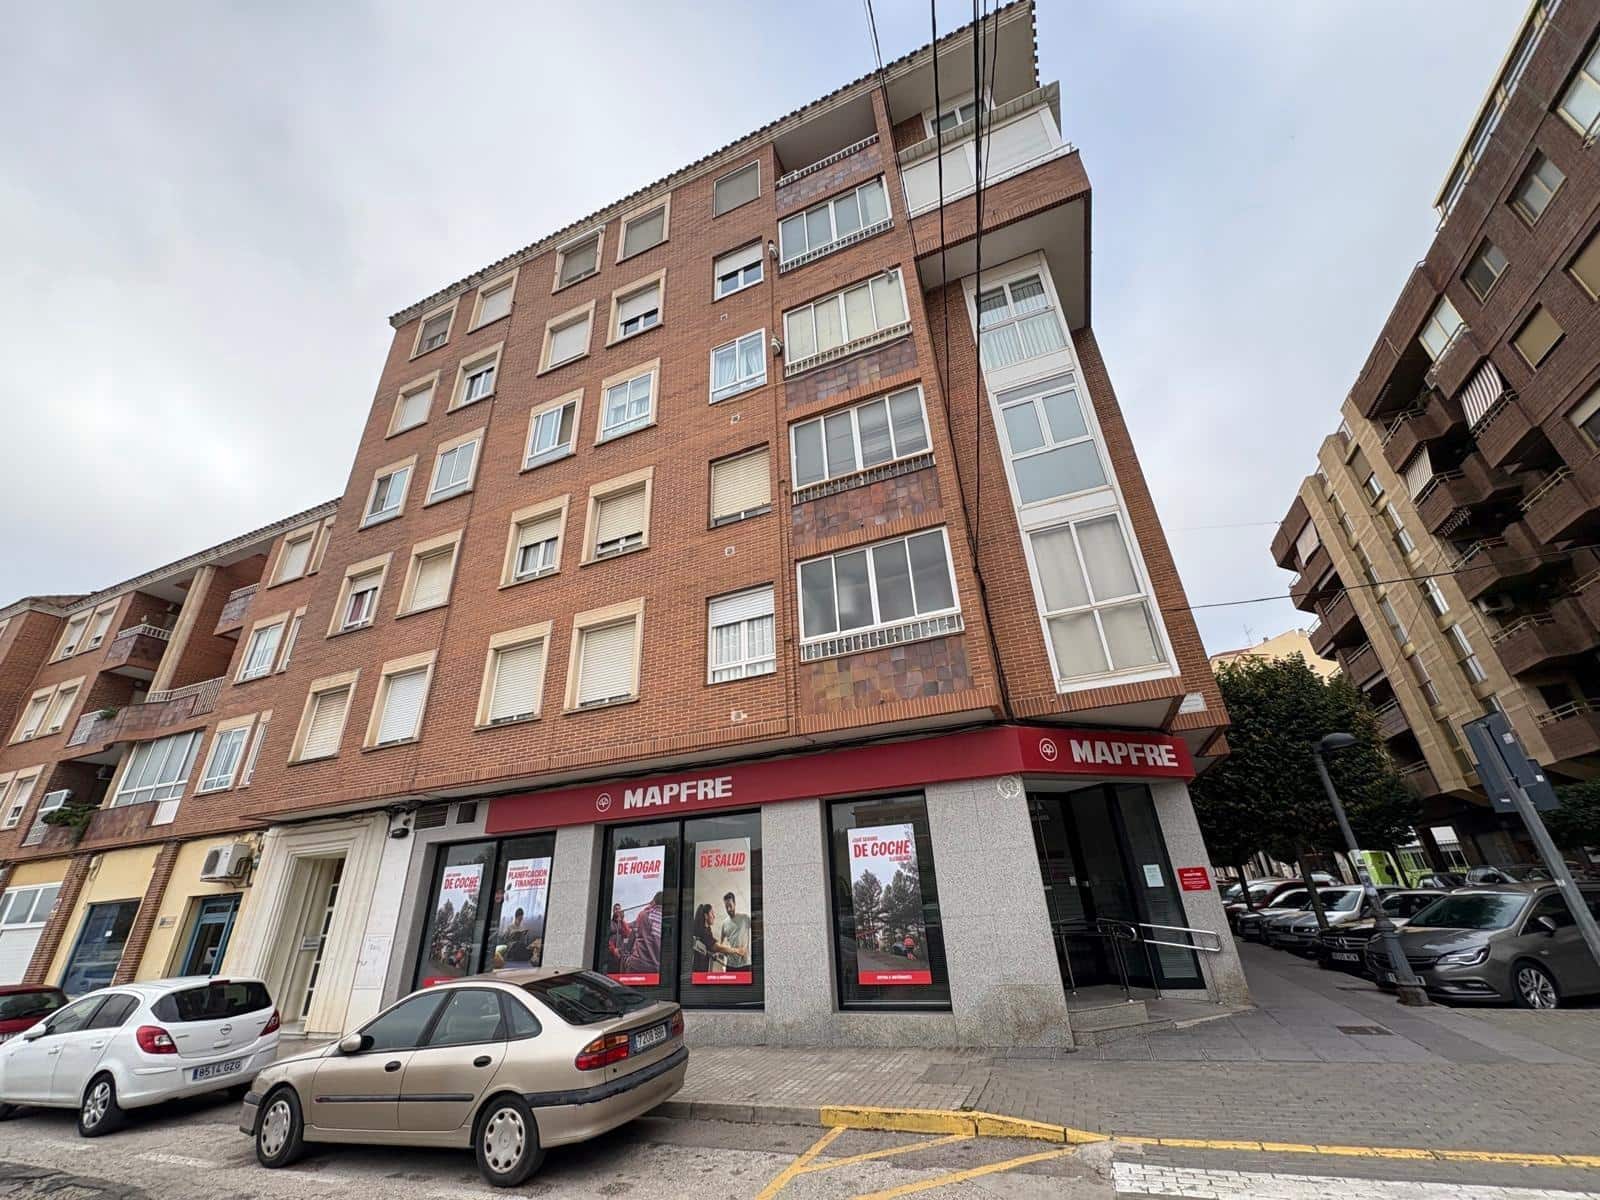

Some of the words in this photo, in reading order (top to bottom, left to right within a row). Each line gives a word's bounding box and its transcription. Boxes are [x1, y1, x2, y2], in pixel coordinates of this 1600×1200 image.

[1071, 739, 1178, 767] MAPFRE
[624, 775, 733, 809] MAPFRE
[853, 843, 868, 858] DE
[871, 839, 910, 857] COCHE
[617, 862, 629, 876] DE
[630, 859, 661, 874] HOGAR
[700, 854, 713, 868] DE
[714, 852, 746, 867] SALUD
[444, 878, 454, 890] DE
[454, 875, 480, 889] COCHE
[199, 1064, 221, 1078] 8514
